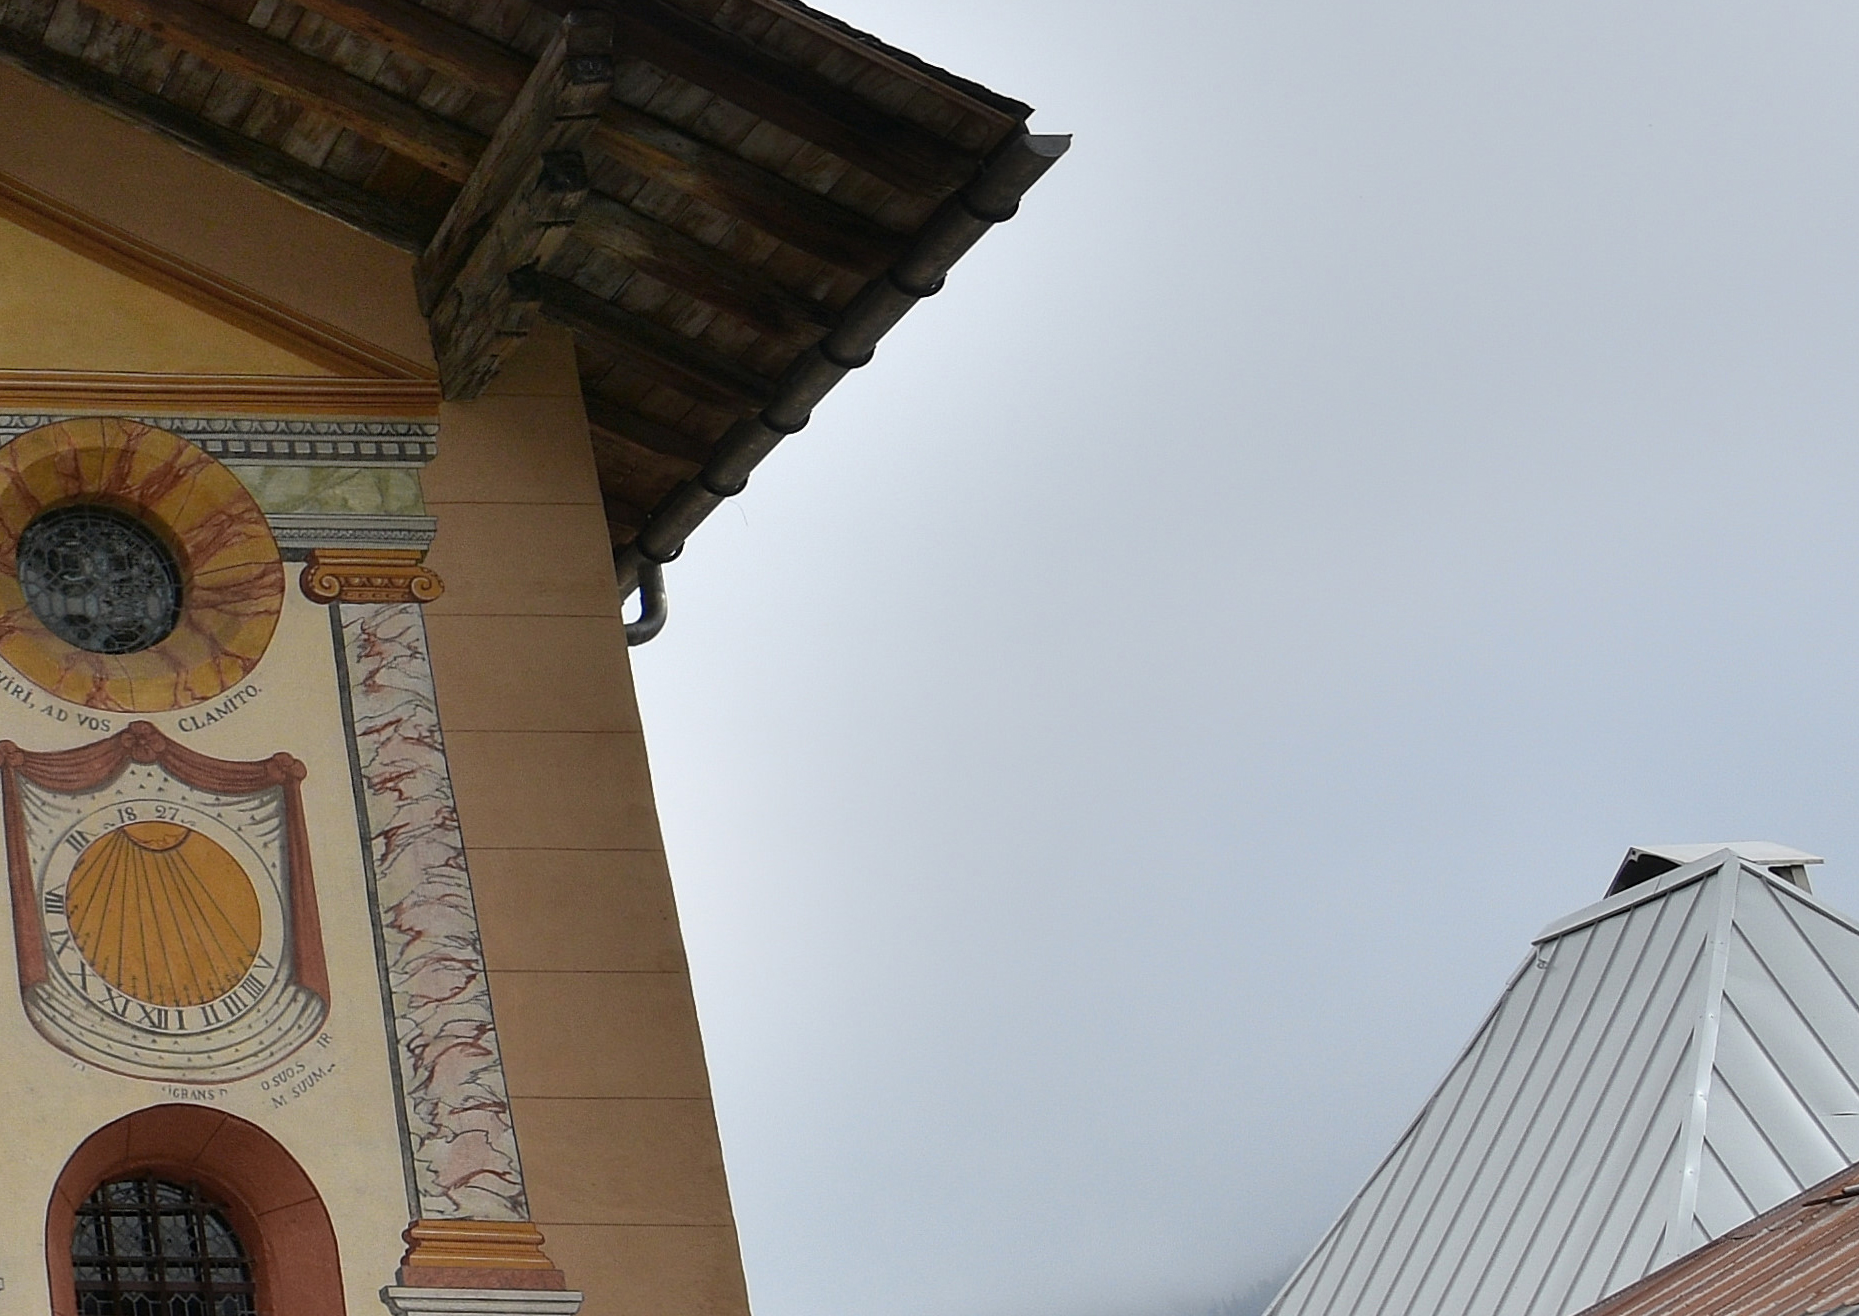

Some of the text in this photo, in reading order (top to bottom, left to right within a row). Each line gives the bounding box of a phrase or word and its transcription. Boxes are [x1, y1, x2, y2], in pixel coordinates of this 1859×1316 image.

[40, 704, 68, 723] AD
[77, 714, 111, 733] VOS
[155, 805, 180, 822] 27
